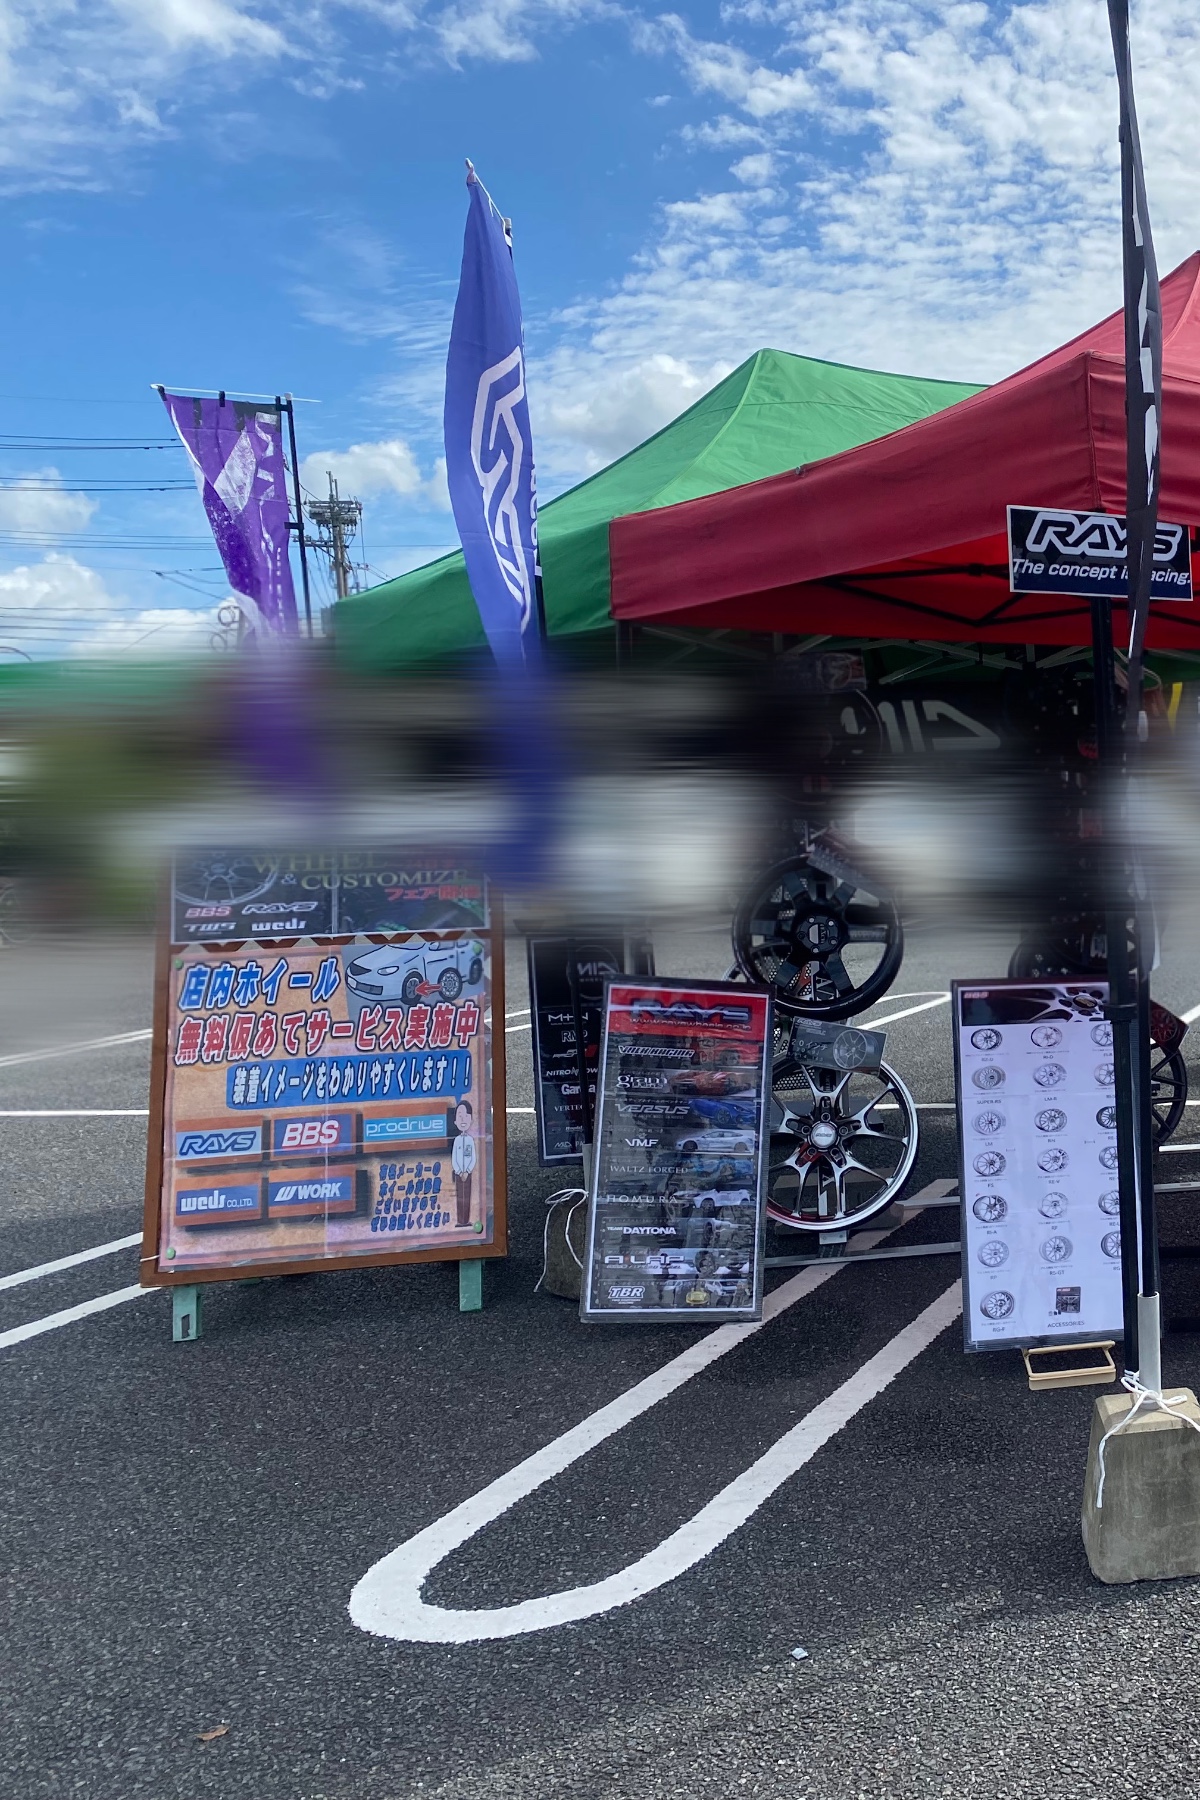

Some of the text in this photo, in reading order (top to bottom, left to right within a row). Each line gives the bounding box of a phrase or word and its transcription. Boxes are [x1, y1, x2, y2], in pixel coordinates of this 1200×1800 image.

[1013, 559, 1044, 574] The
[1048, 564, 1116, 580] concept
[1151, 570, 1190, 585] acing.
[301, 869, 468, 890] CUSTOMIZE
[185, 901, 318, 918] BBS RAYS
[251, 917, 307, 931] weds
[179, 957, 340, 1010] 店内ホイール
[631, 999, 751, 1022] RAYS
[174, 1001, 480, 1065] 無料仮あてサービス実施中
[617, 1075, 668, 1088] gram
[615, 1103, 690, 1114] VERSUS
[282, 1120, 339, 1148] BBS
[366, 1118, 443, 1137] prodrive
[180, 1130, 256, 1156] RAYS
[610, 1165, 645, 1173] WALTZ
[181, 1190, 225, 1212] weds
[607, 1195, 678, 1203] HOMURA
[623, 1227, 676, 1235] DAYTONA
[609, 1286, 644, 1298] TBR
